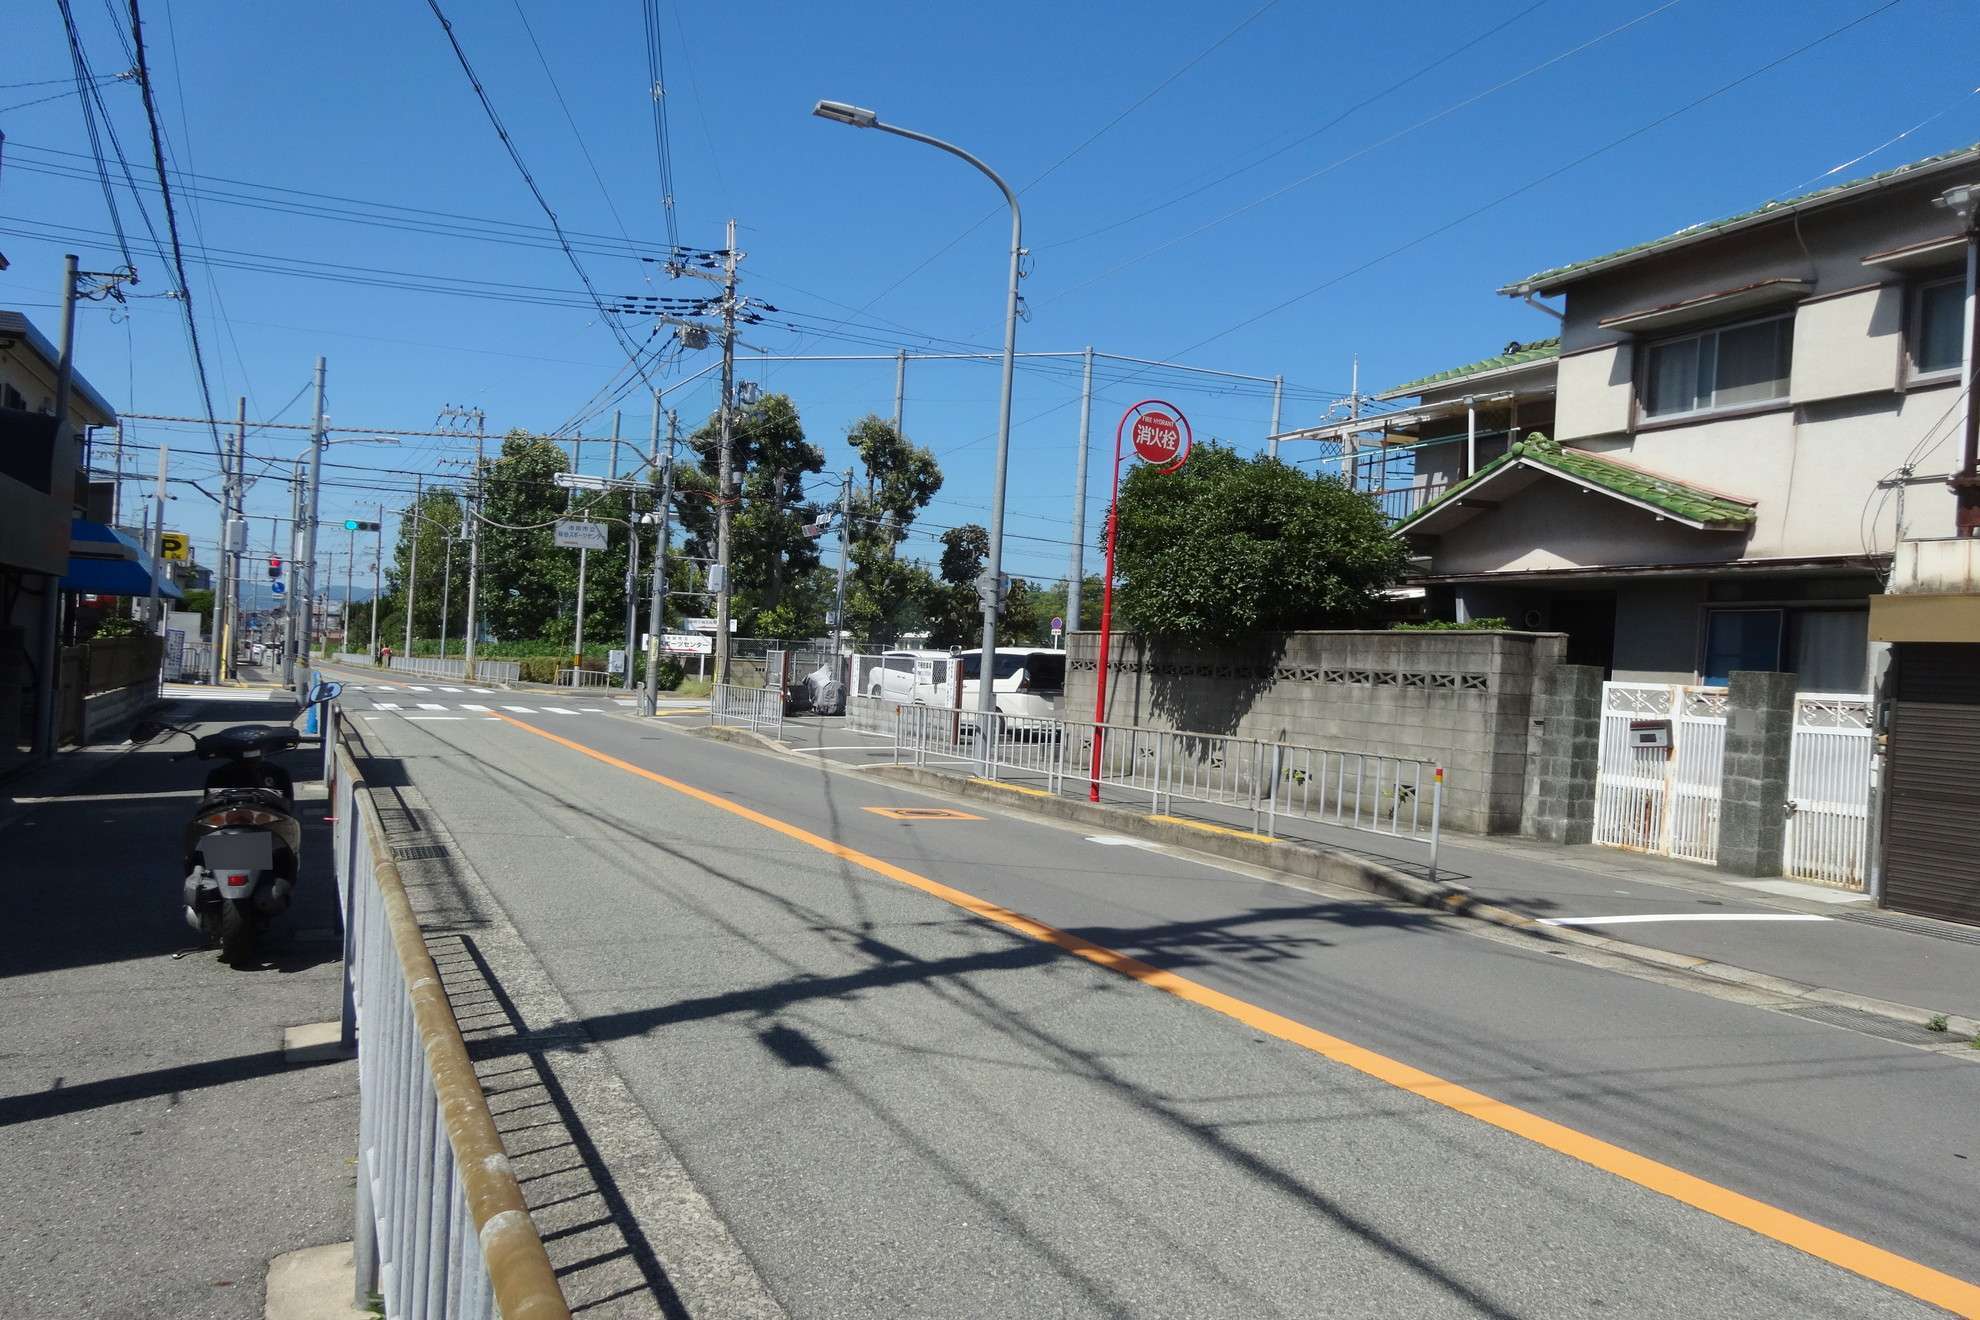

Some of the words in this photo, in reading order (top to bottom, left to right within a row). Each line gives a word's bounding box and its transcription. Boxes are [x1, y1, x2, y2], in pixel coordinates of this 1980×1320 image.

[1135, 423, 1178, 451] 消火栓
[161, 538, 182, 558] P
